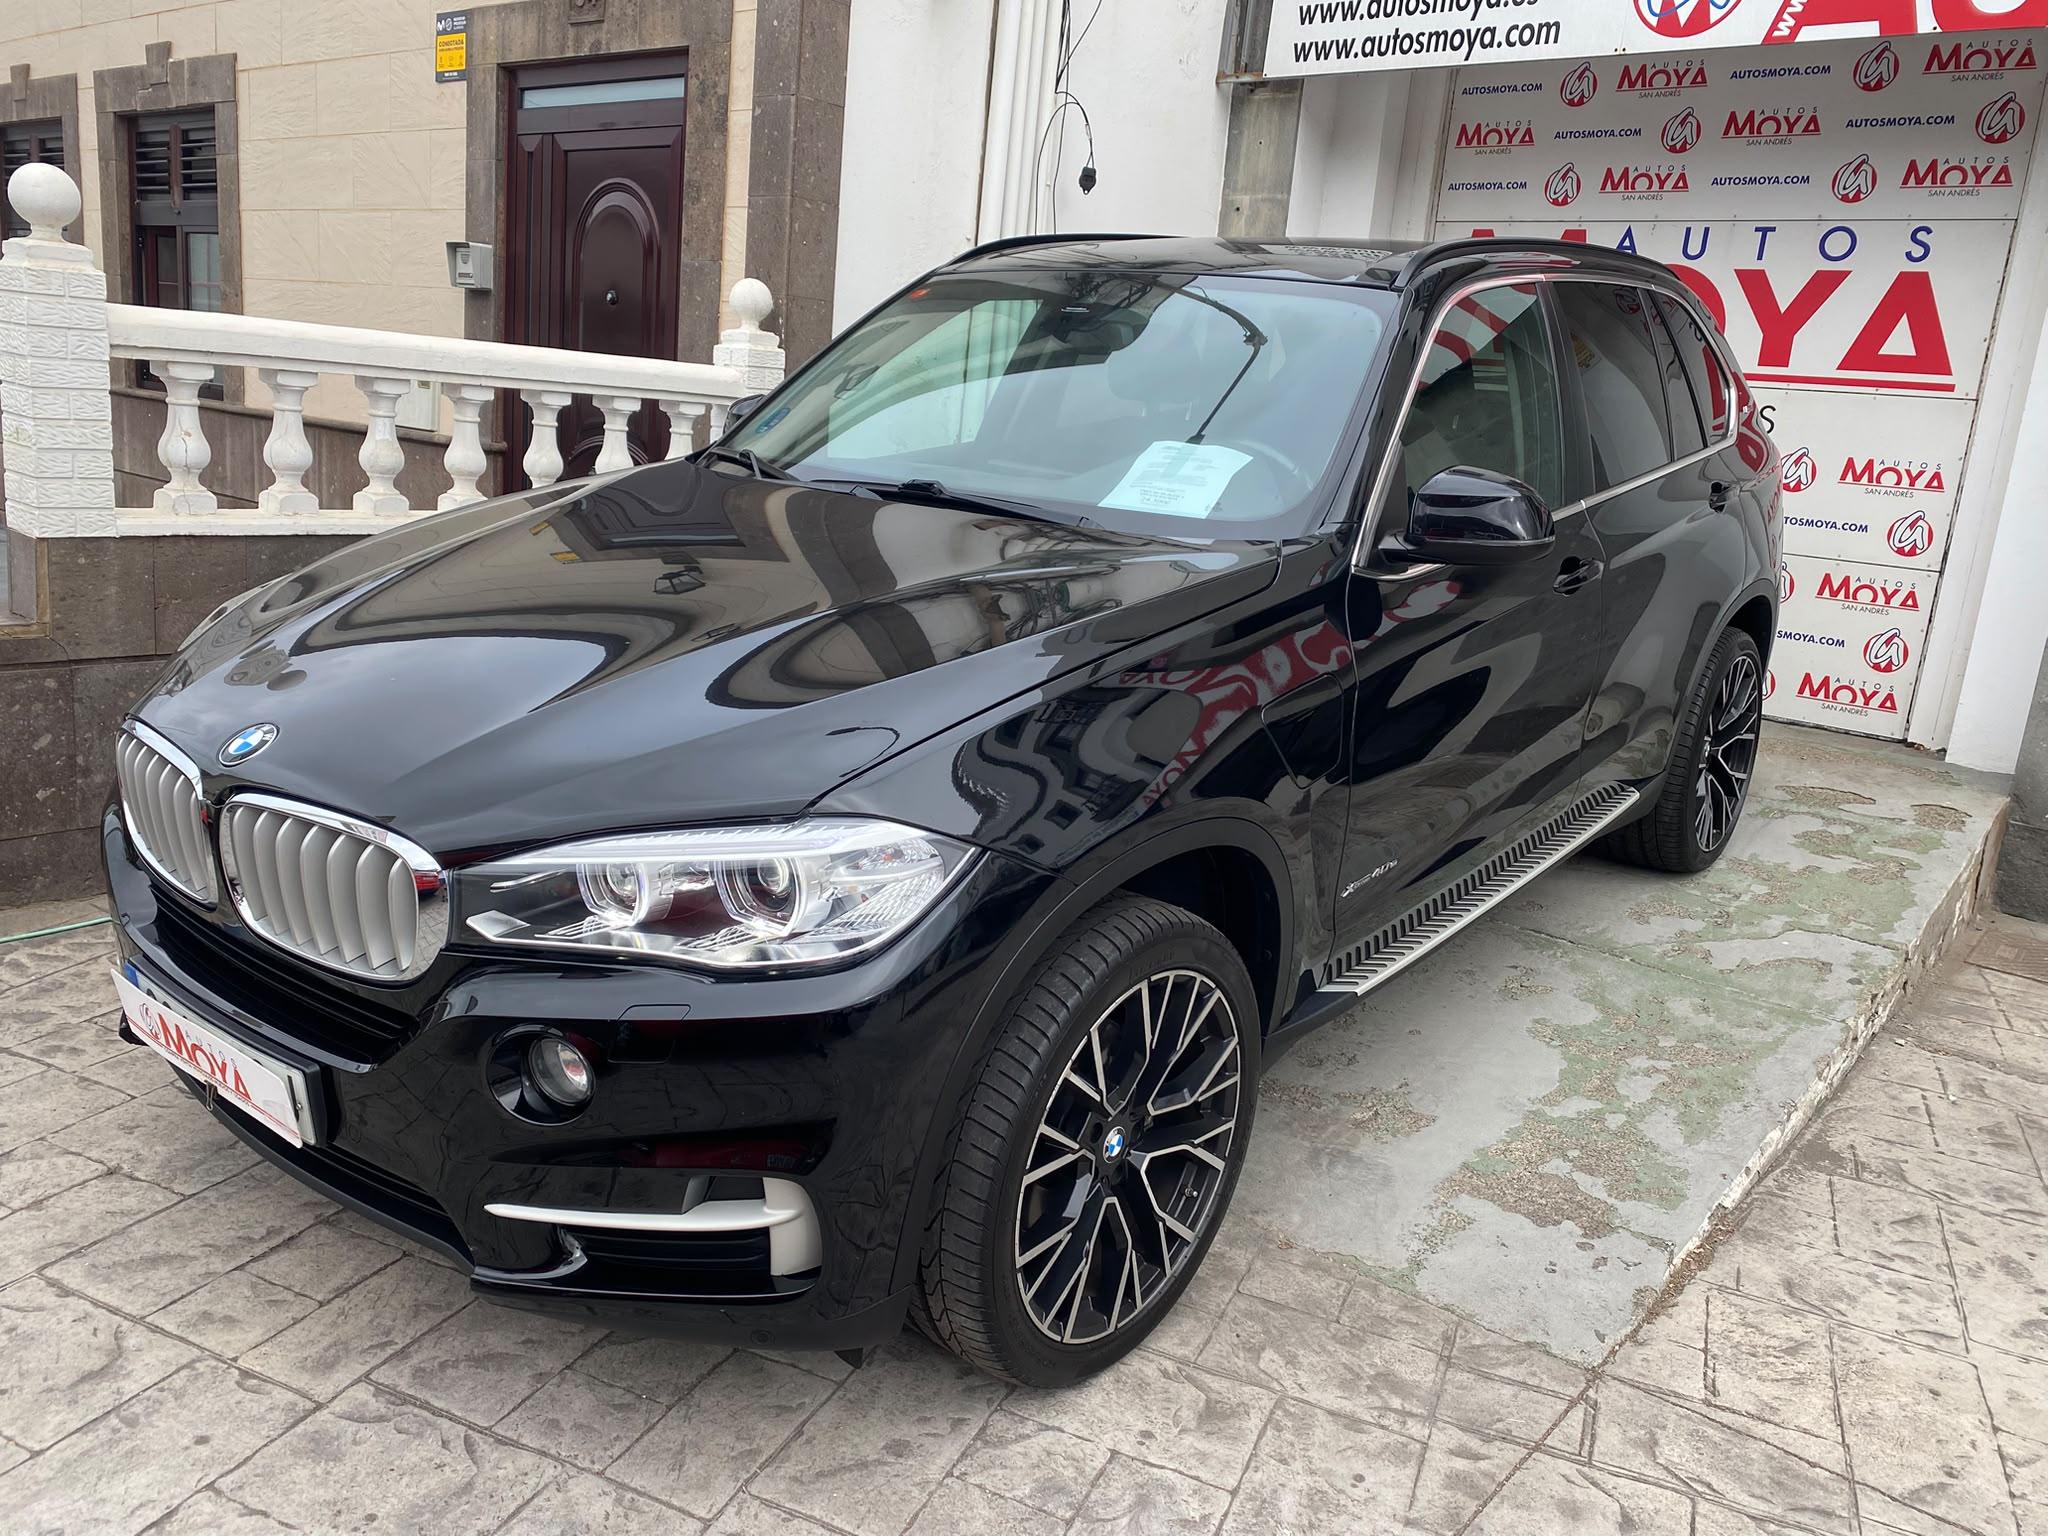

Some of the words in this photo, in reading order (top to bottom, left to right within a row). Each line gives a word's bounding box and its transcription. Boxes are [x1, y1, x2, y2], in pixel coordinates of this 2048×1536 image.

[1299, 0, 1538, 25] www.autosmoy.
[1294, 20, 1561, 62] www.autosmoya.com
[1966, 38, 2033, 50] AUTOS
[1924, 43, 2037, 69] MOYA
[1651, 59, 1705, 70] AUTOS
[1617, 63, 1708, 88] MOYA
[1730, 65, 1831, 80] AUTOSMOYA.COM
[1951, 73, 1973, 82] SAN
[1974, 71, 2004, 81] ANDRÉS
[1462, 83, 1543, 96] AUTOSMOYA.COM
[1639, 89, 1656, 98] SAN
[1657, 88, 1681, 98] ANDRÉS
[1759, 107, 1818, 116] AUTOS
[1484, 120, 1532, 129] AUTOS
[1722, 109, 1821, 136] MOYA
[1845, 115, 1955, 129] AUTOSMOYA.COM
[1456, 122, 1535, 146] MOYA
[1554, 128, 1642, 140] AUTOSMOYA.COM
[1746, 138, 1764, 147] SAN
[1765, 137, 1793, 146] ANDRÉS
[1491, 147, 1512, 155] ANDRÉS
[1943, 156, 2009, 165] AUTOS
[1633, 164, 1686, 173] AUTOS
[1901, 158, 2013, 185] MOYA
[1600, 167, 1689, 190] MOYA
[1711, 175, 1810, 187] AUTOSMOYA.COM
[1448, 181, 1527, 191] AUTOSMOYA.COM
[1928, 189, 1949, 197] SAN
[1950, 187, 1981, 197] ANDRÉS
[1638, 193, 1664, 201] ANDRÉS
[1615, 225, 1934, 262] AUTOS
[1879, 458, 1942, 471] AUTOS
[1839, 457, 1945, 490] MOYA
[1864, 487, 1882, 496] SAN
[1883, 488, 1914, 499] ANDRÉS
[1855, 576, 1916, 590] AUTOS
[1817, 573, 1919, 609] MOYA
[1841, 603, 1858, 612] SAN
[1859, 605, 1890, 616] ANDRÉS
[1835, 677, 1894, 692] AUTOS
[1797, 672, 1898, 711] MOYA
[1821, 703, 1838, 712] SAN
[1839, 705, 1869, 717] ANDRÉS
[158, 1013, 252, 1101] MOYA
